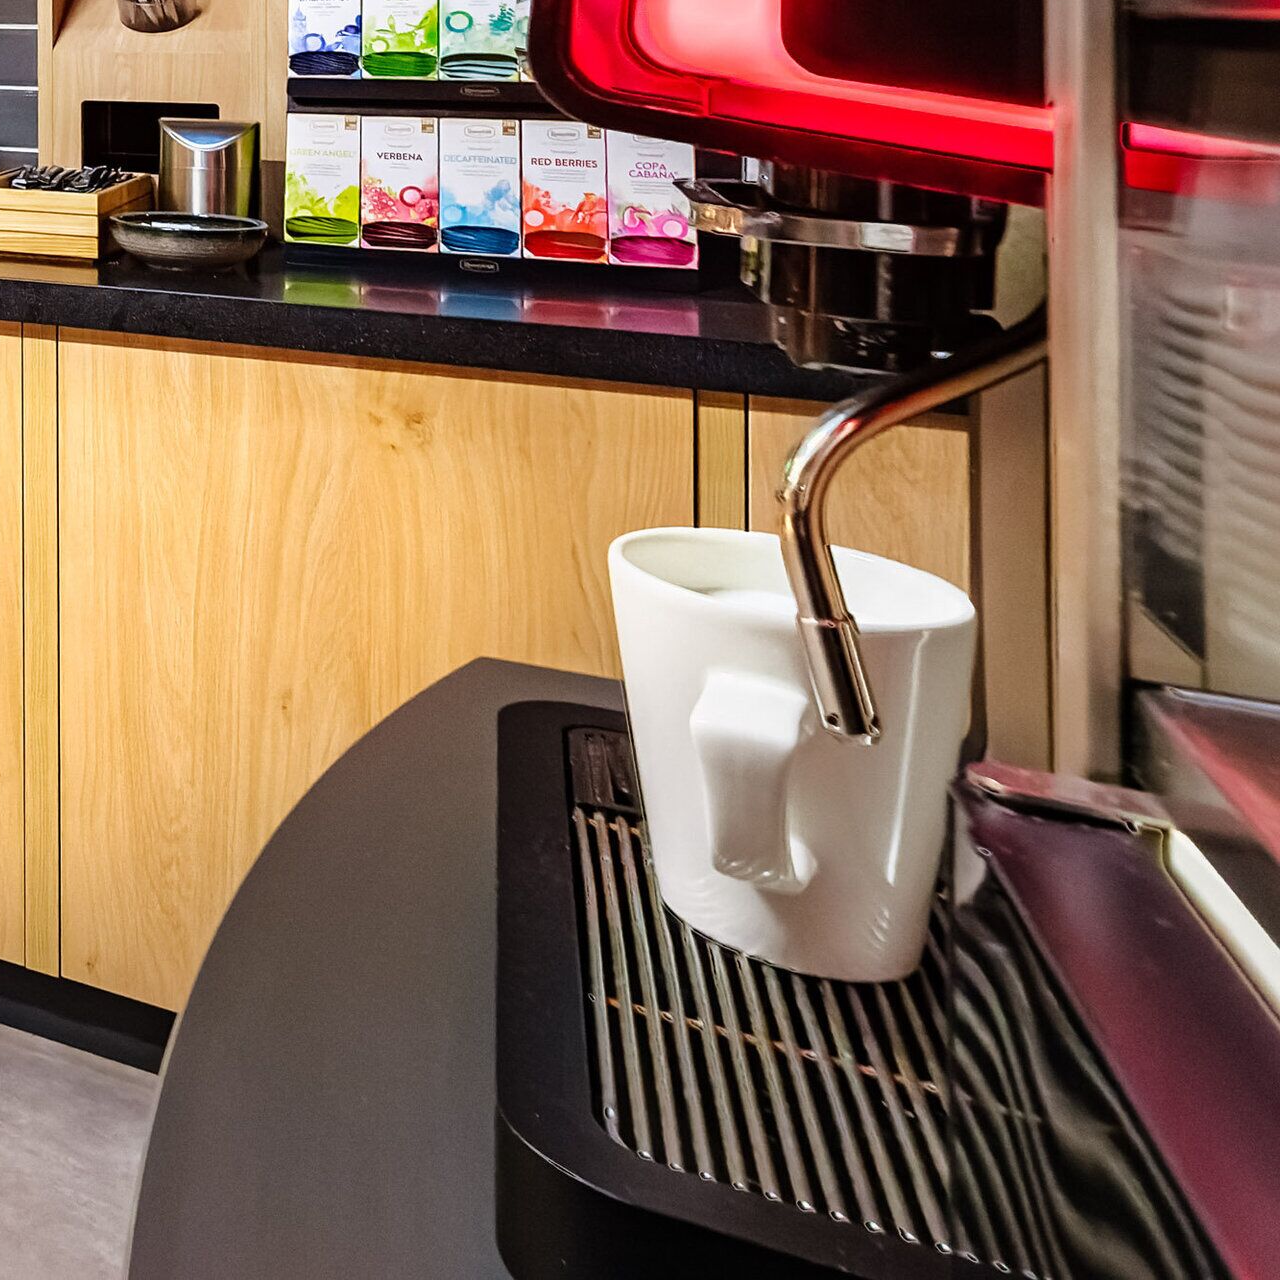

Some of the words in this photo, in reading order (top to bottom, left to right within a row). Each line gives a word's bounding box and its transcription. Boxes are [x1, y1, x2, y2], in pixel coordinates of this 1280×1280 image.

[377, 152, 424, 162] VERBENA
[443, 154, 518, 165] DECAFFEINATED
[531, 157, 552, 166] RED
[555, 159, 599, 169] BERRIES
[635, 161, 667, 171] COPA
